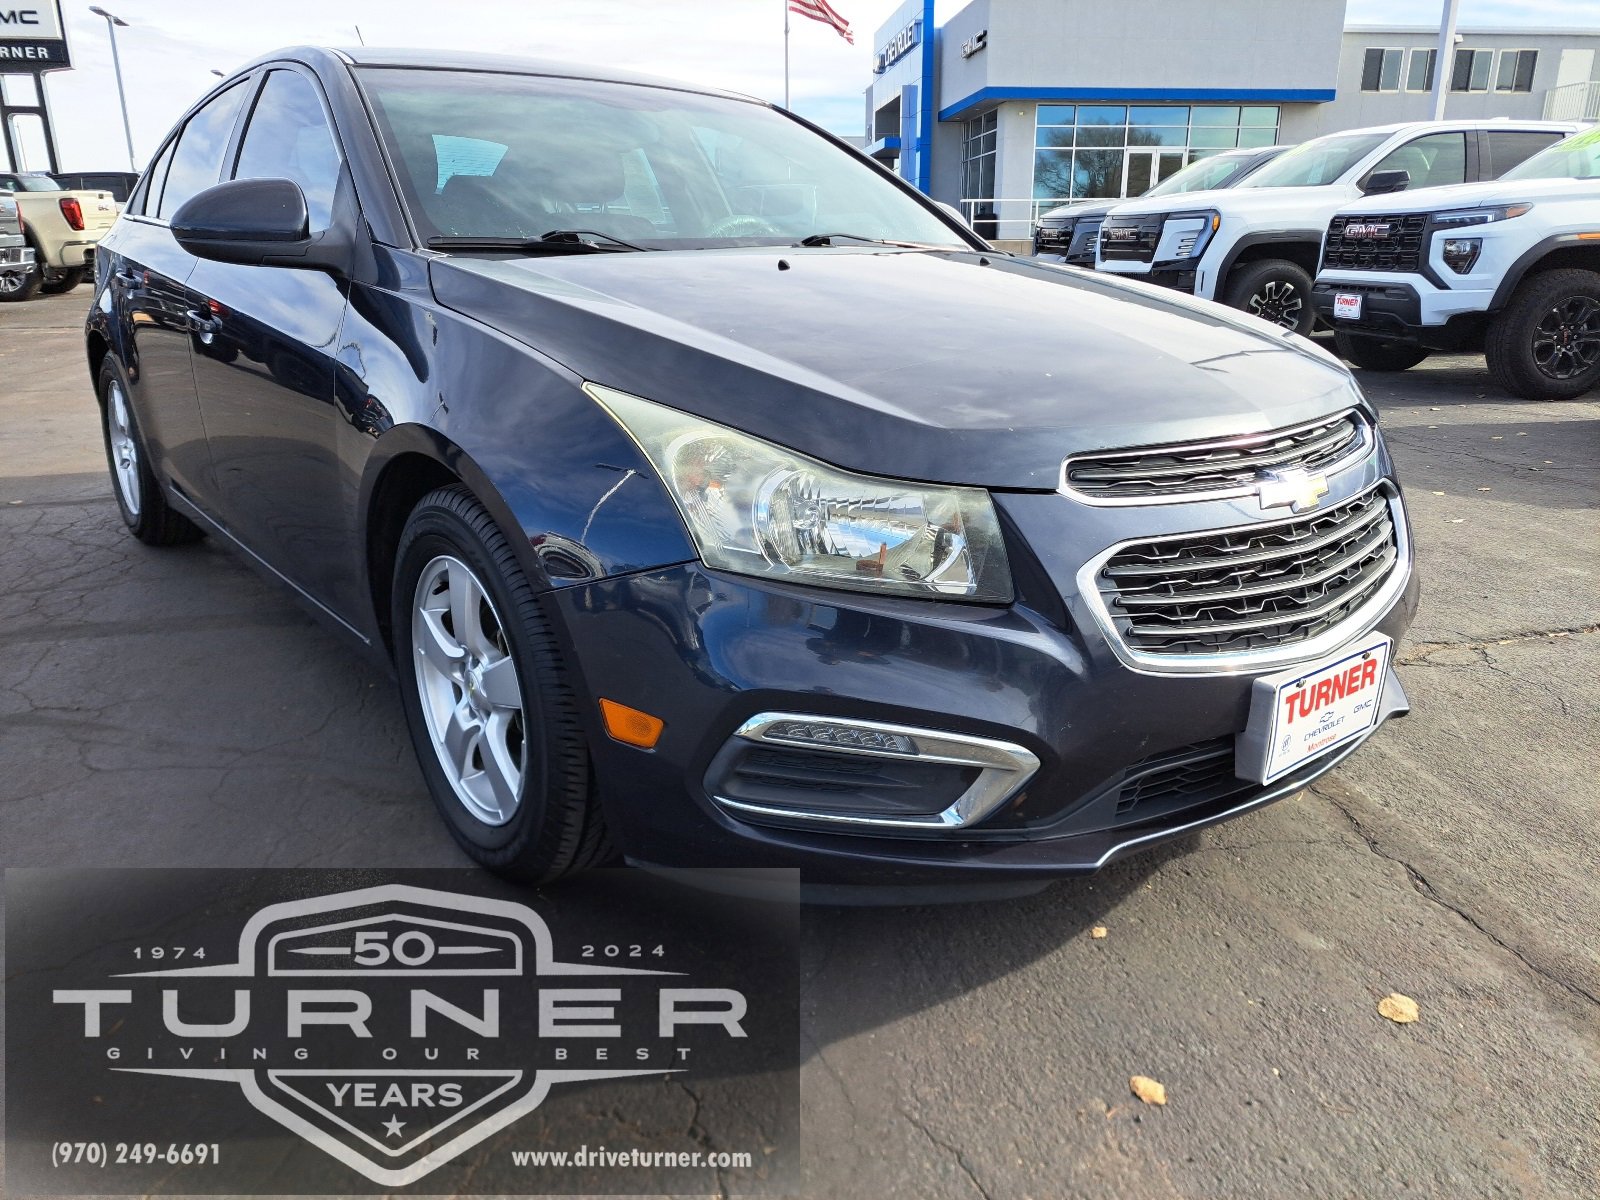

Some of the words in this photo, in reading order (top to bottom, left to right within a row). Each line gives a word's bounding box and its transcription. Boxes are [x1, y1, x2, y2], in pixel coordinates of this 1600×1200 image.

[884, 20, 921, 67] CHEVROLET
[961, 30, 987, 58] GMC
[0, 46, 49, 59] RNER
[1110, 228, 1137, 240] GMC
[1345, 224, 1390, 238] GMC
[1337, 298, 1359, 306] TURNER
[1285, 658, 1377, 724] TURNER
[1353, 700, 1373, 714] GMC
[1304, 715, 1346, 741] CHEVROLET
[1307, 733, 1337, 753] Montrose
